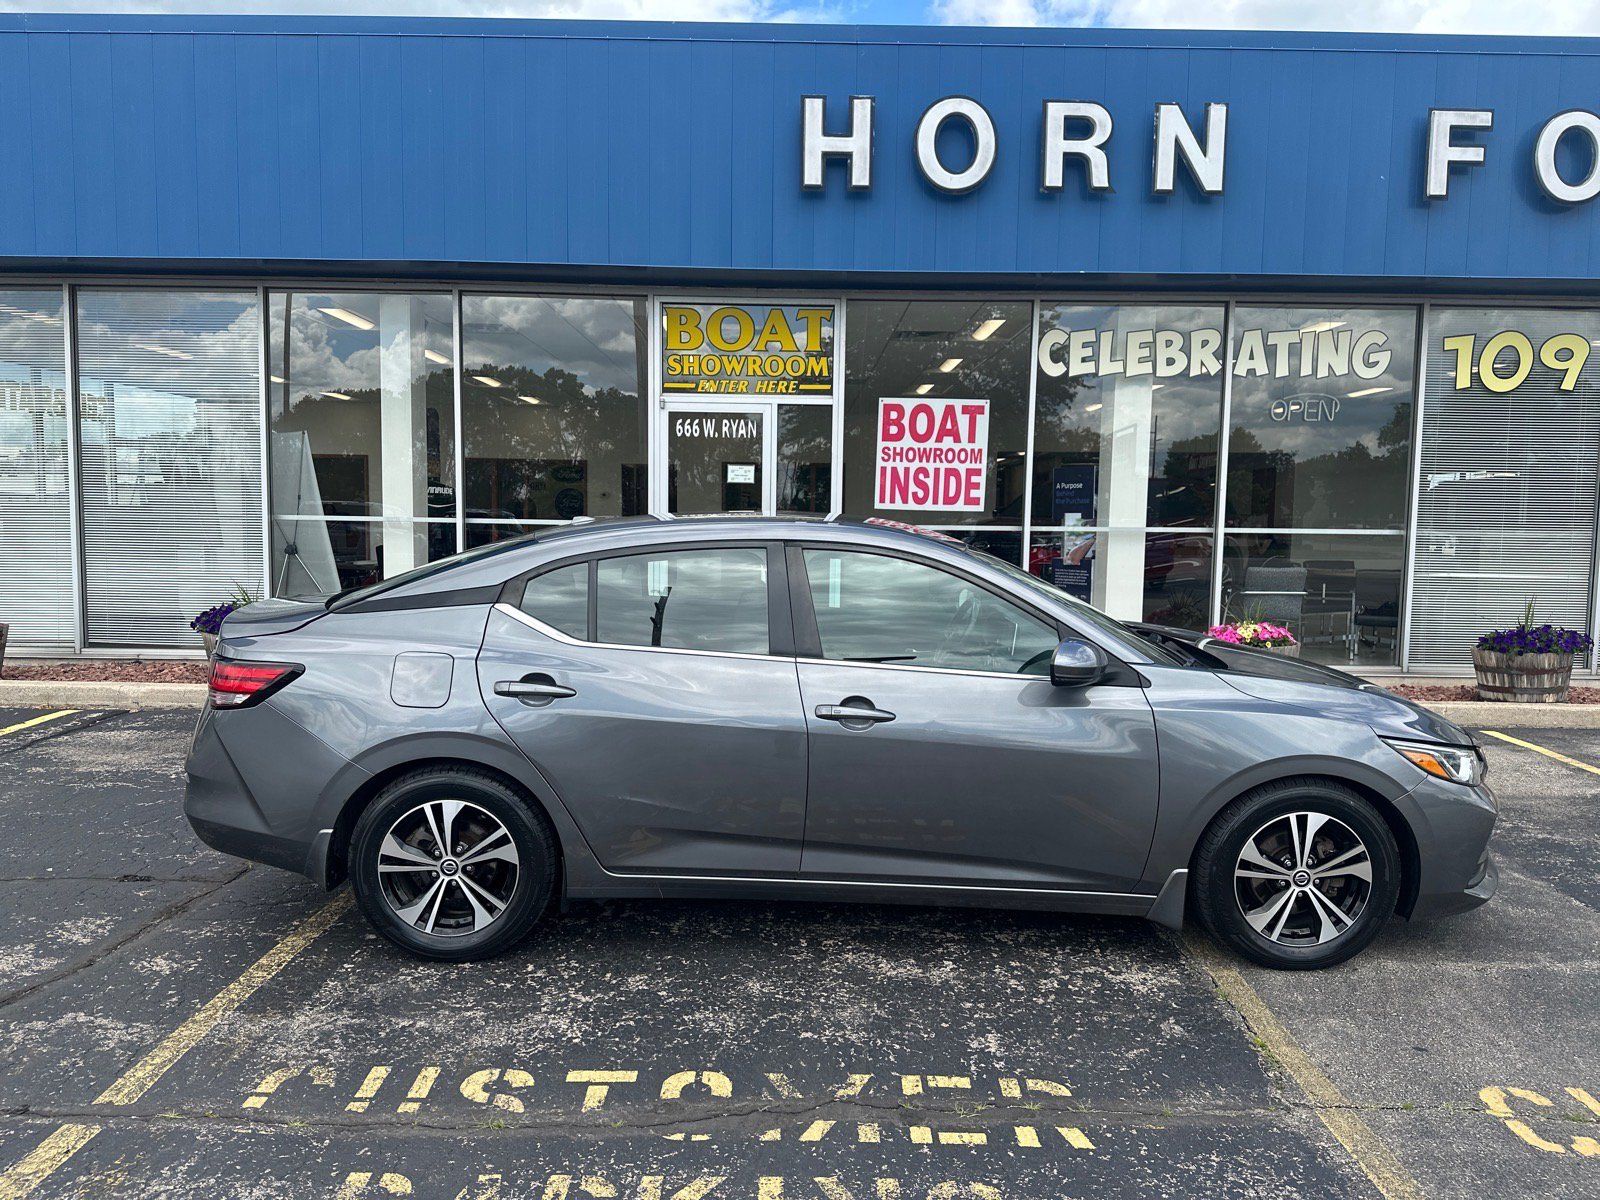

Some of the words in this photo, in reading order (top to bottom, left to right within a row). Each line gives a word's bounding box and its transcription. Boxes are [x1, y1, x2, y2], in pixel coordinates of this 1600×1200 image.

[801, 95, 1229, 196] HORN
[1424, 109, 1600, 204] FO
[663, 307, 834, 352] BOAT
[667, 354, 829, 377] SHOWROOM
[1037, 328, 1393, 379] CELEBRATING
[1443, 329, 1591, 393] 109
[697, 380, 749, 393] ENTER
[755, 381, 799, 394] HERE
[881, 403, 985, 443] BOAT
[1270, 398, 1337, 423] OPEN
[676, 419, 700, 437] 666
[702, 419, 719, 438] W.
[722, 419, 757, 439] RYAN
[881, 446, 983, 464] SHOWROOM
[879, 466, 982, 505] INSIDE
[1061, 482, 1083, 490] Purpose
